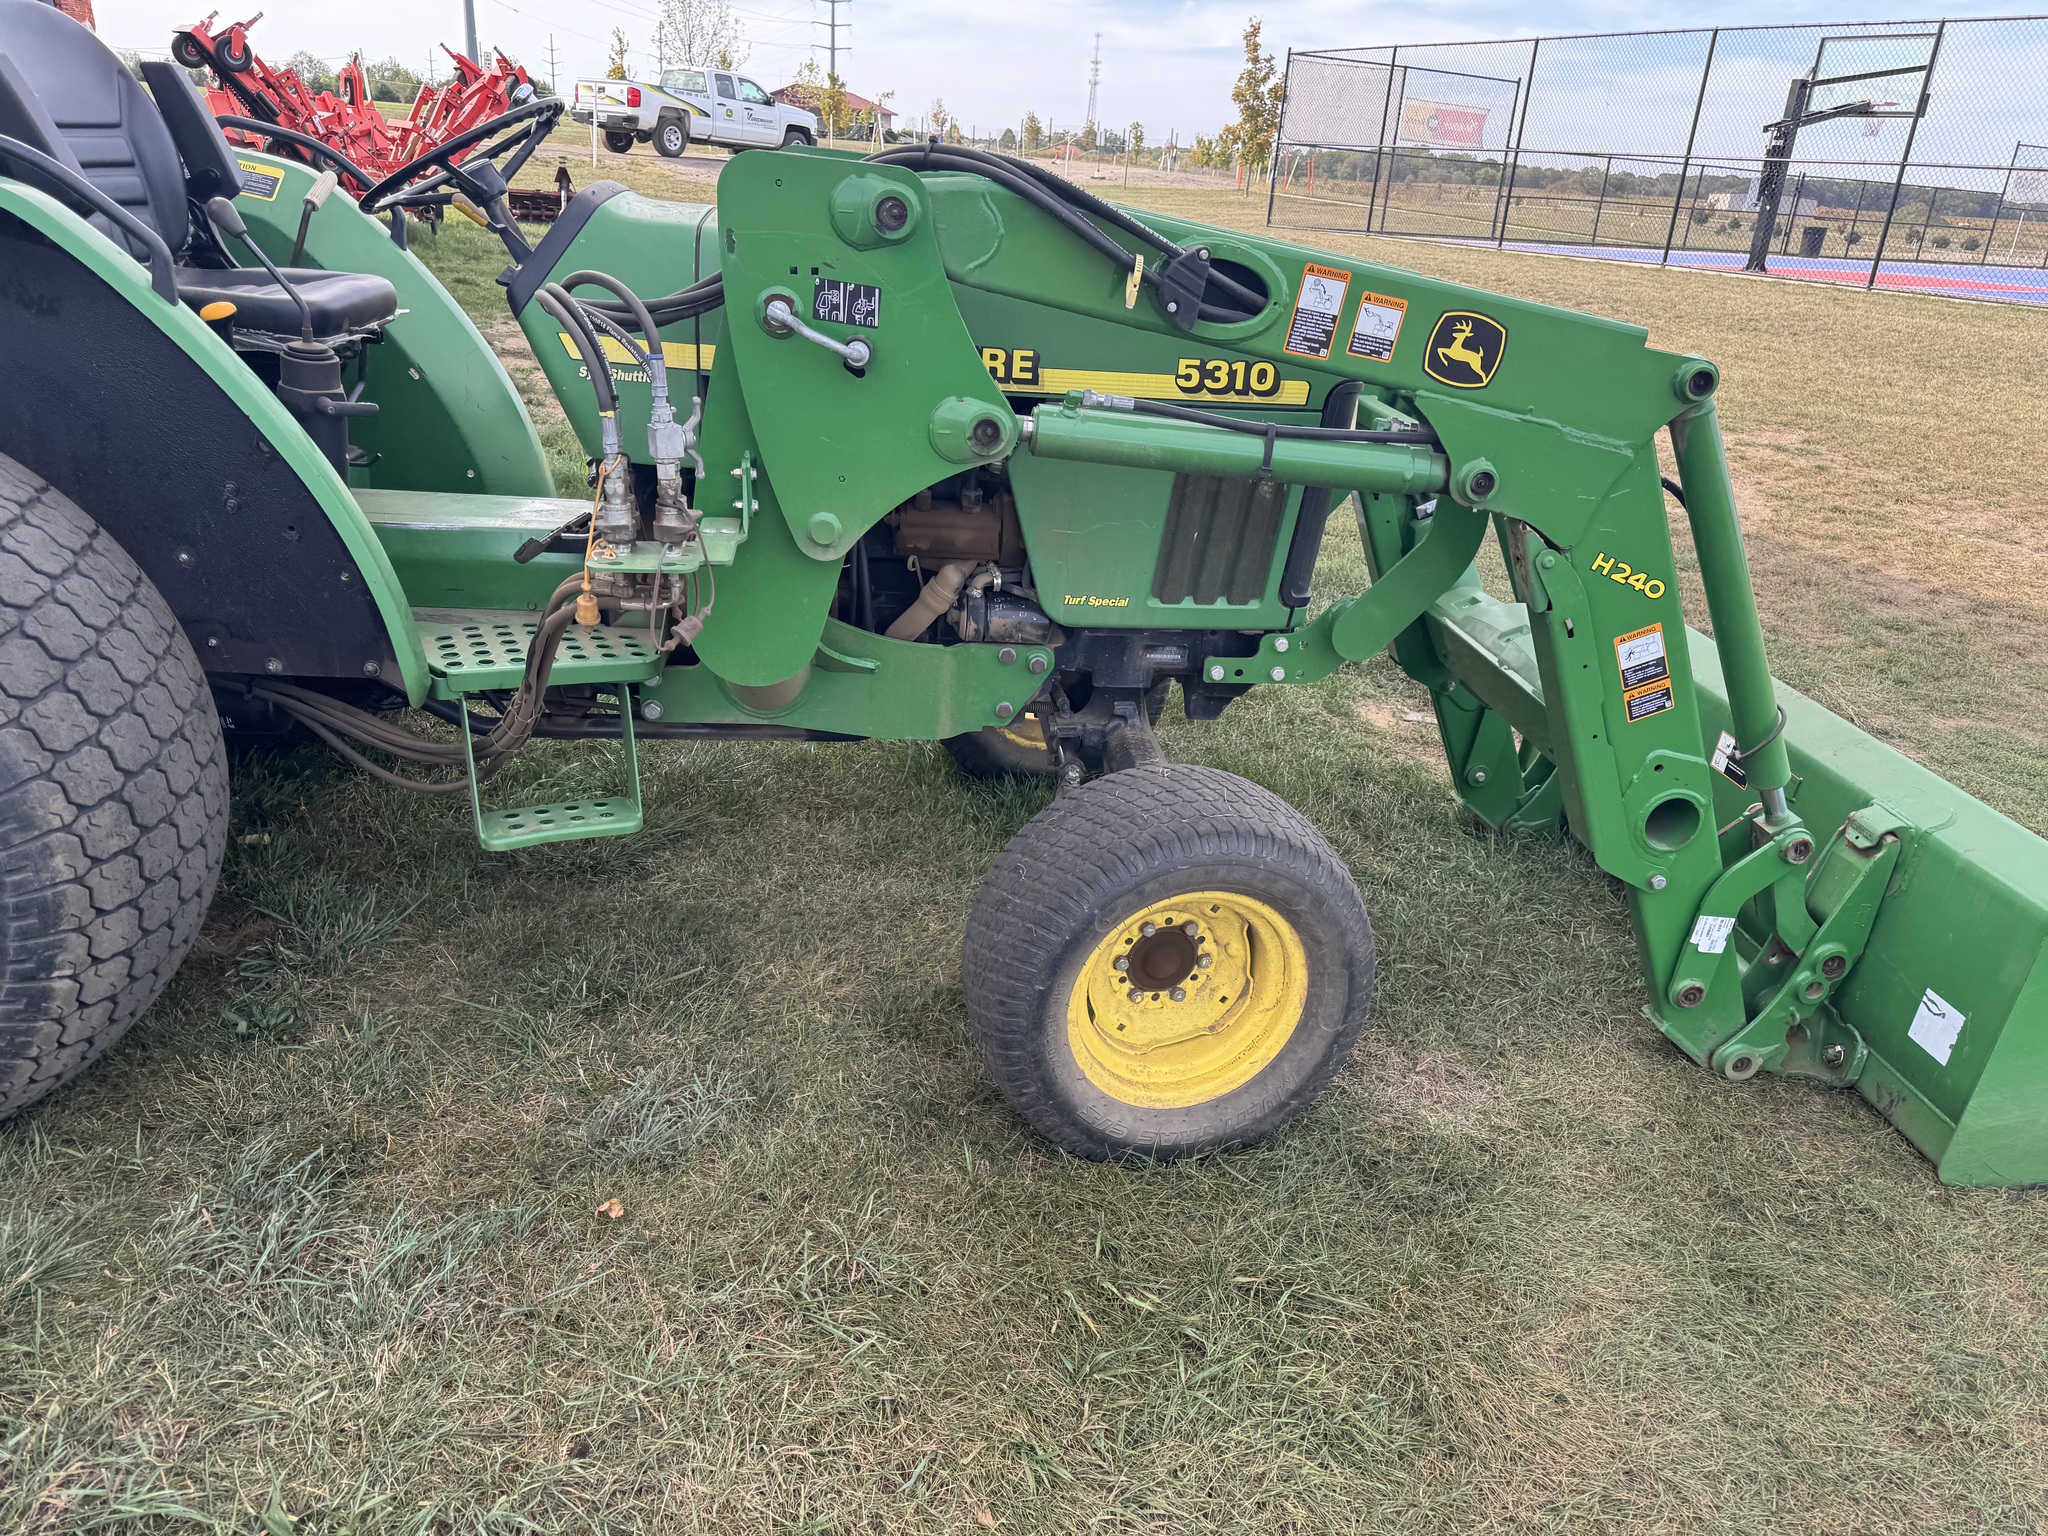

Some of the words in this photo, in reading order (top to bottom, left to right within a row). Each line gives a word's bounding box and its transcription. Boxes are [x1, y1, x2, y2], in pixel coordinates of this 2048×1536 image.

[1316, 267, 1349, 280] WARNING
[1373, 296, 1405, 309] WARNING
[606, 326, 621, 340] Flame
[620, 338, 643, 363] Resistant
[1175, 357, 1279, 394] 5310
[1591, 552, 1666, 599] H240
[1064, 594, 1087, 606] Turf
[1087, 596, 1130, 608] Special
[1626, 626, 1656, 640] WARNING
[1637, 682, 1666, 695] WARNING
[1225, 1072, 1298, 1133] MULTI
[1136, 1125, 1216, 1146] TRAC
